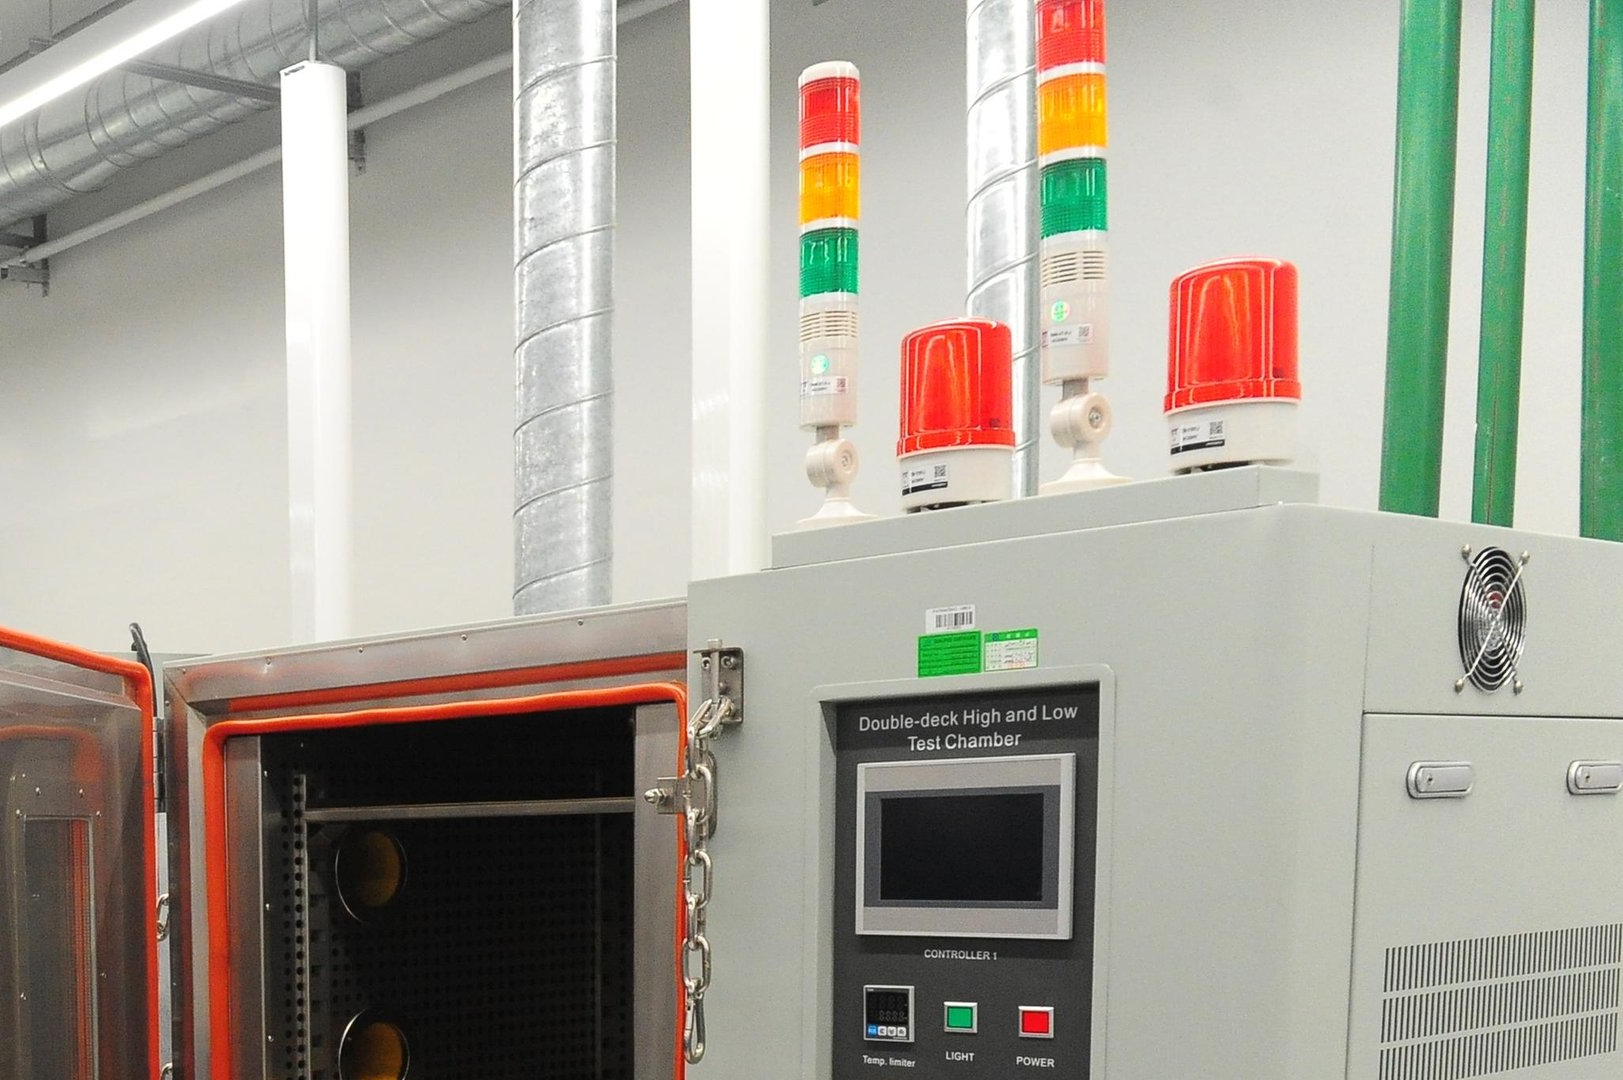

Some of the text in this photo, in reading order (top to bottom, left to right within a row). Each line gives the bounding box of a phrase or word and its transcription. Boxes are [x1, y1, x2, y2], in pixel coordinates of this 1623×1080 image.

[858, 704, 1078, 732] Double-deck High and Low
[907, 731, 1022, 752] Test Chamber
[924, 949, 998, 960] CONTROLLER 1
[862, 1055, 916, 1068] Temp. limiter
[945, 1051, 974, 1062] LIGHT
[1016, 1056, 1055, 1068] POWER
